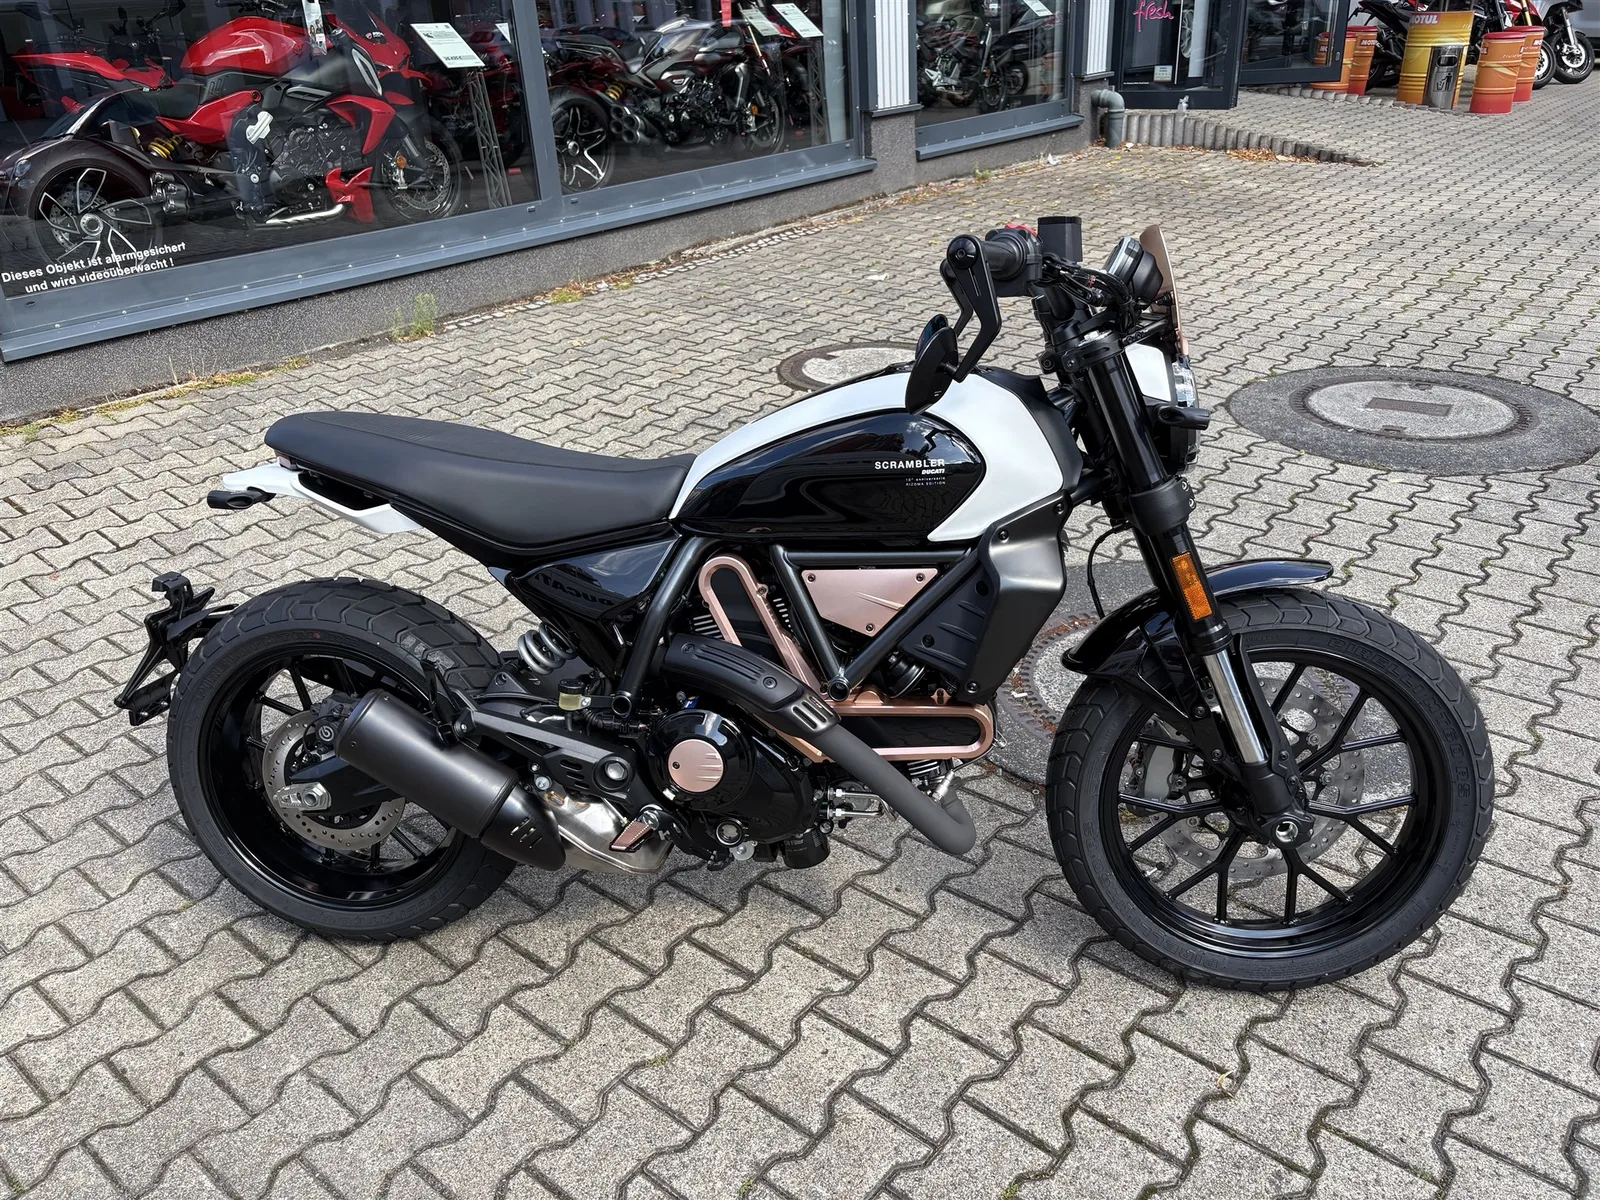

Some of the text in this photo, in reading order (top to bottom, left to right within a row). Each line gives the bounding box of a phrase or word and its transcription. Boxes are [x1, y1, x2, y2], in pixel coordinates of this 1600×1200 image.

[1133, 0, 1174, 32] fresh
[1, 242, 186, 283] Dieses Objekt ist alarmgesichert
[25, 257, 174, 294] und wird videoüberwacht !
[874, 458, 945, 469] SCRAMBLER
[1327, 637, 1425, 694] PIRELLI
